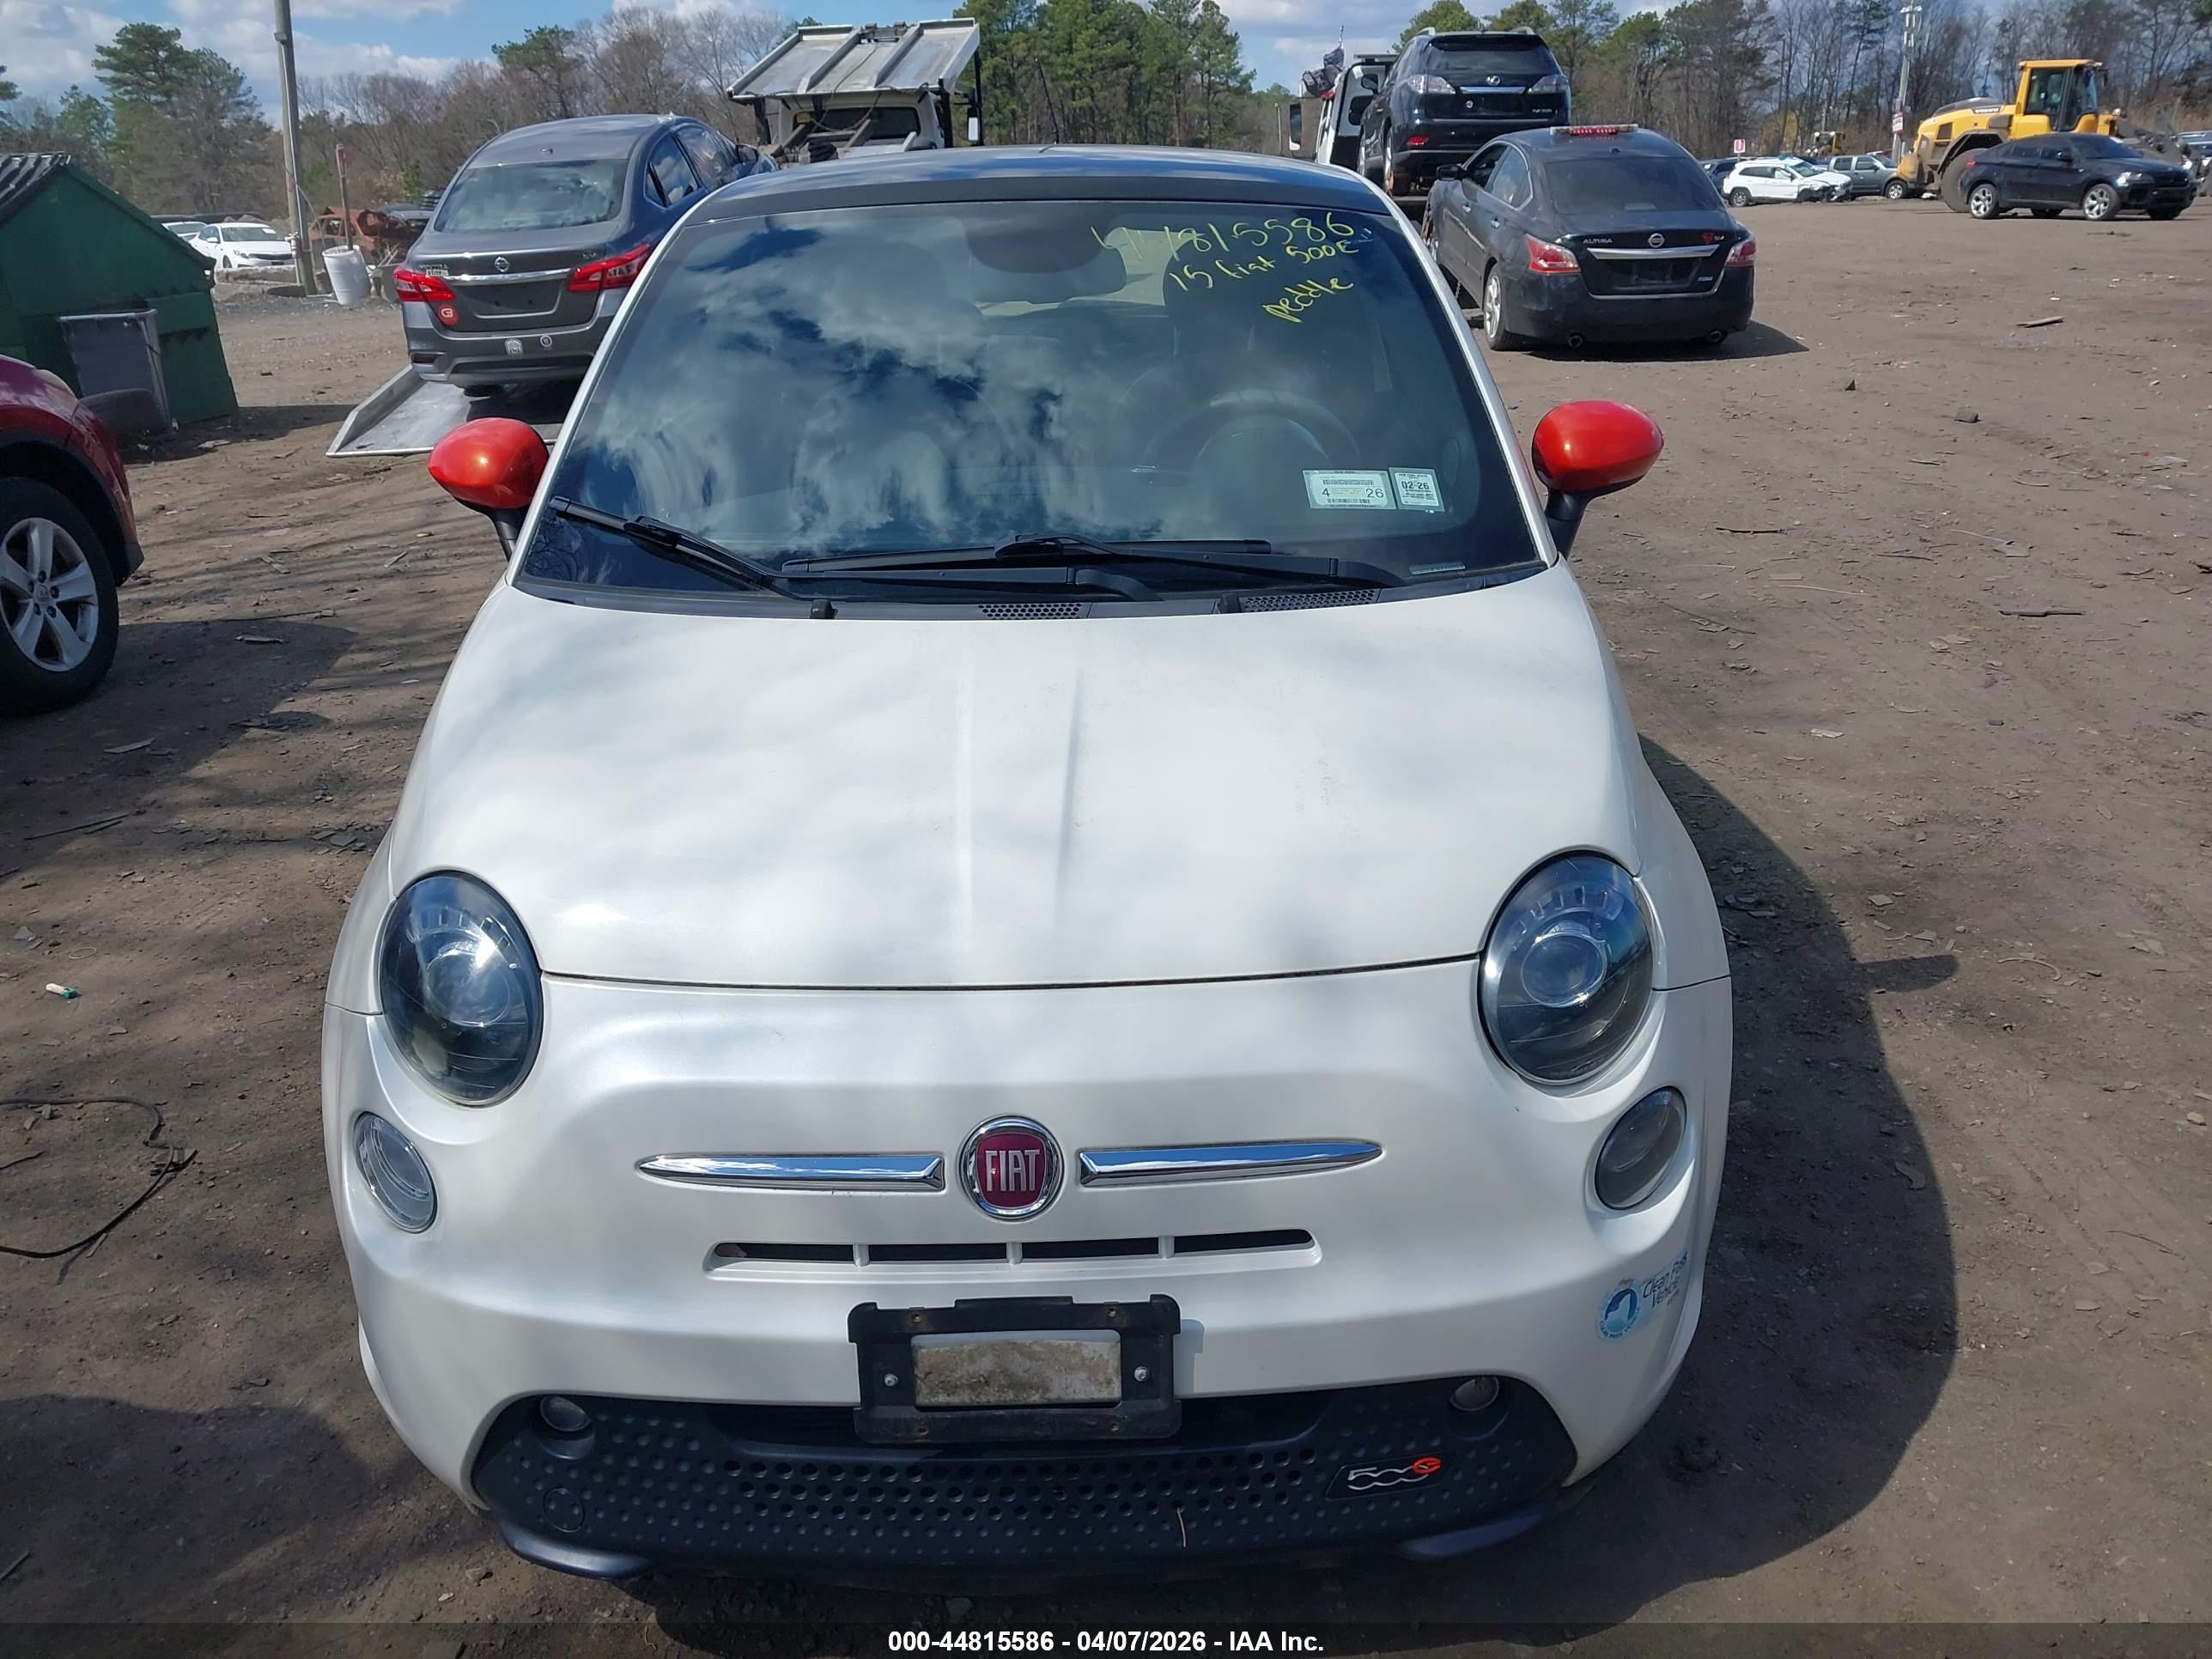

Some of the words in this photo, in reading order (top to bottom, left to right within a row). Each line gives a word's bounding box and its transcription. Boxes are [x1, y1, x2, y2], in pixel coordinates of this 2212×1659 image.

[1169, 264, 1213, 291] 15
[1322, 488, 1330, 497] 4
[1365, 488, 1384, 498] 26
[985, 1149, 1040, 1192] FIAT
